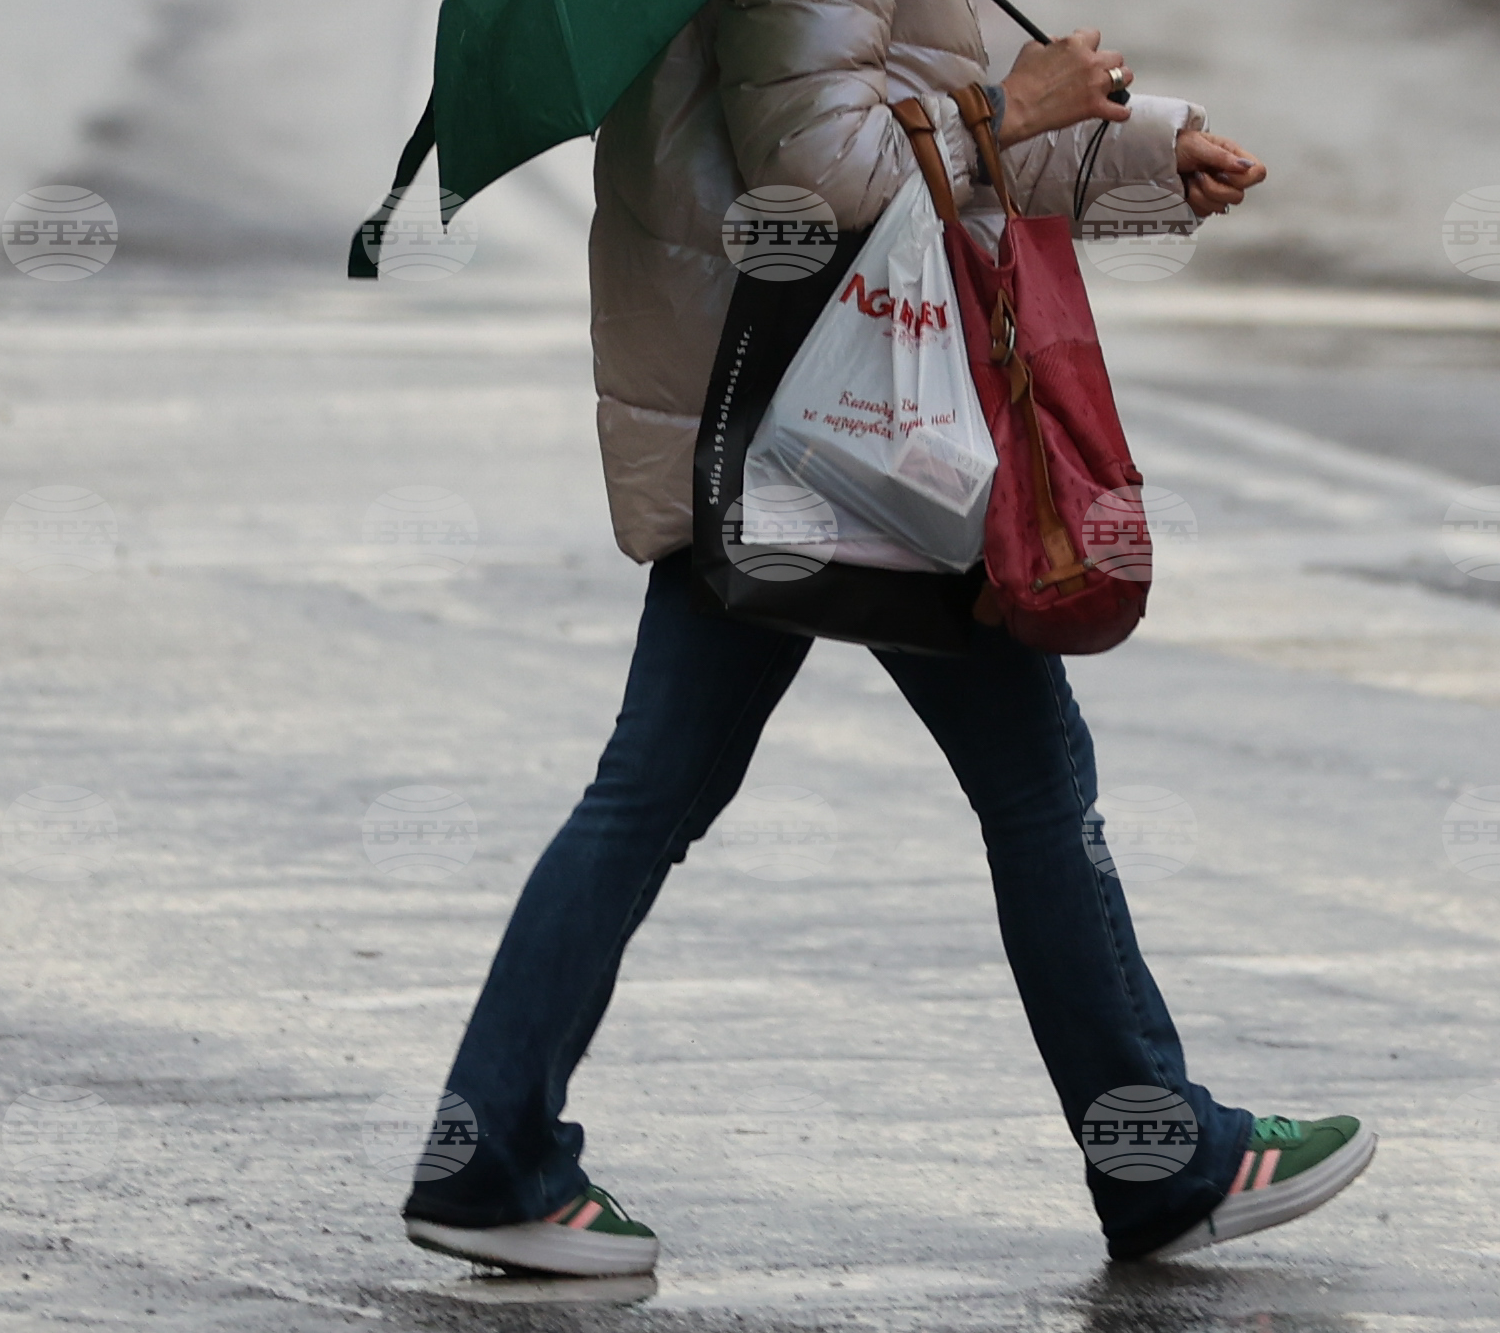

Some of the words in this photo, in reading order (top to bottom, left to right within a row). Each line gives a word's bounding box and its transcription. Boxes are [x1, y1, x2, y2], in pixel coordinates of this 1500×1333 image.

[736, 325, 753, 356] Str.
[717, 359, 743, 431] Solunska
[899, 414, 924, 439] при
[931, 408, 956, 427] нас!
[713, 434, 725, 453] 19
[708, 456, 724, 505] Sofia,
